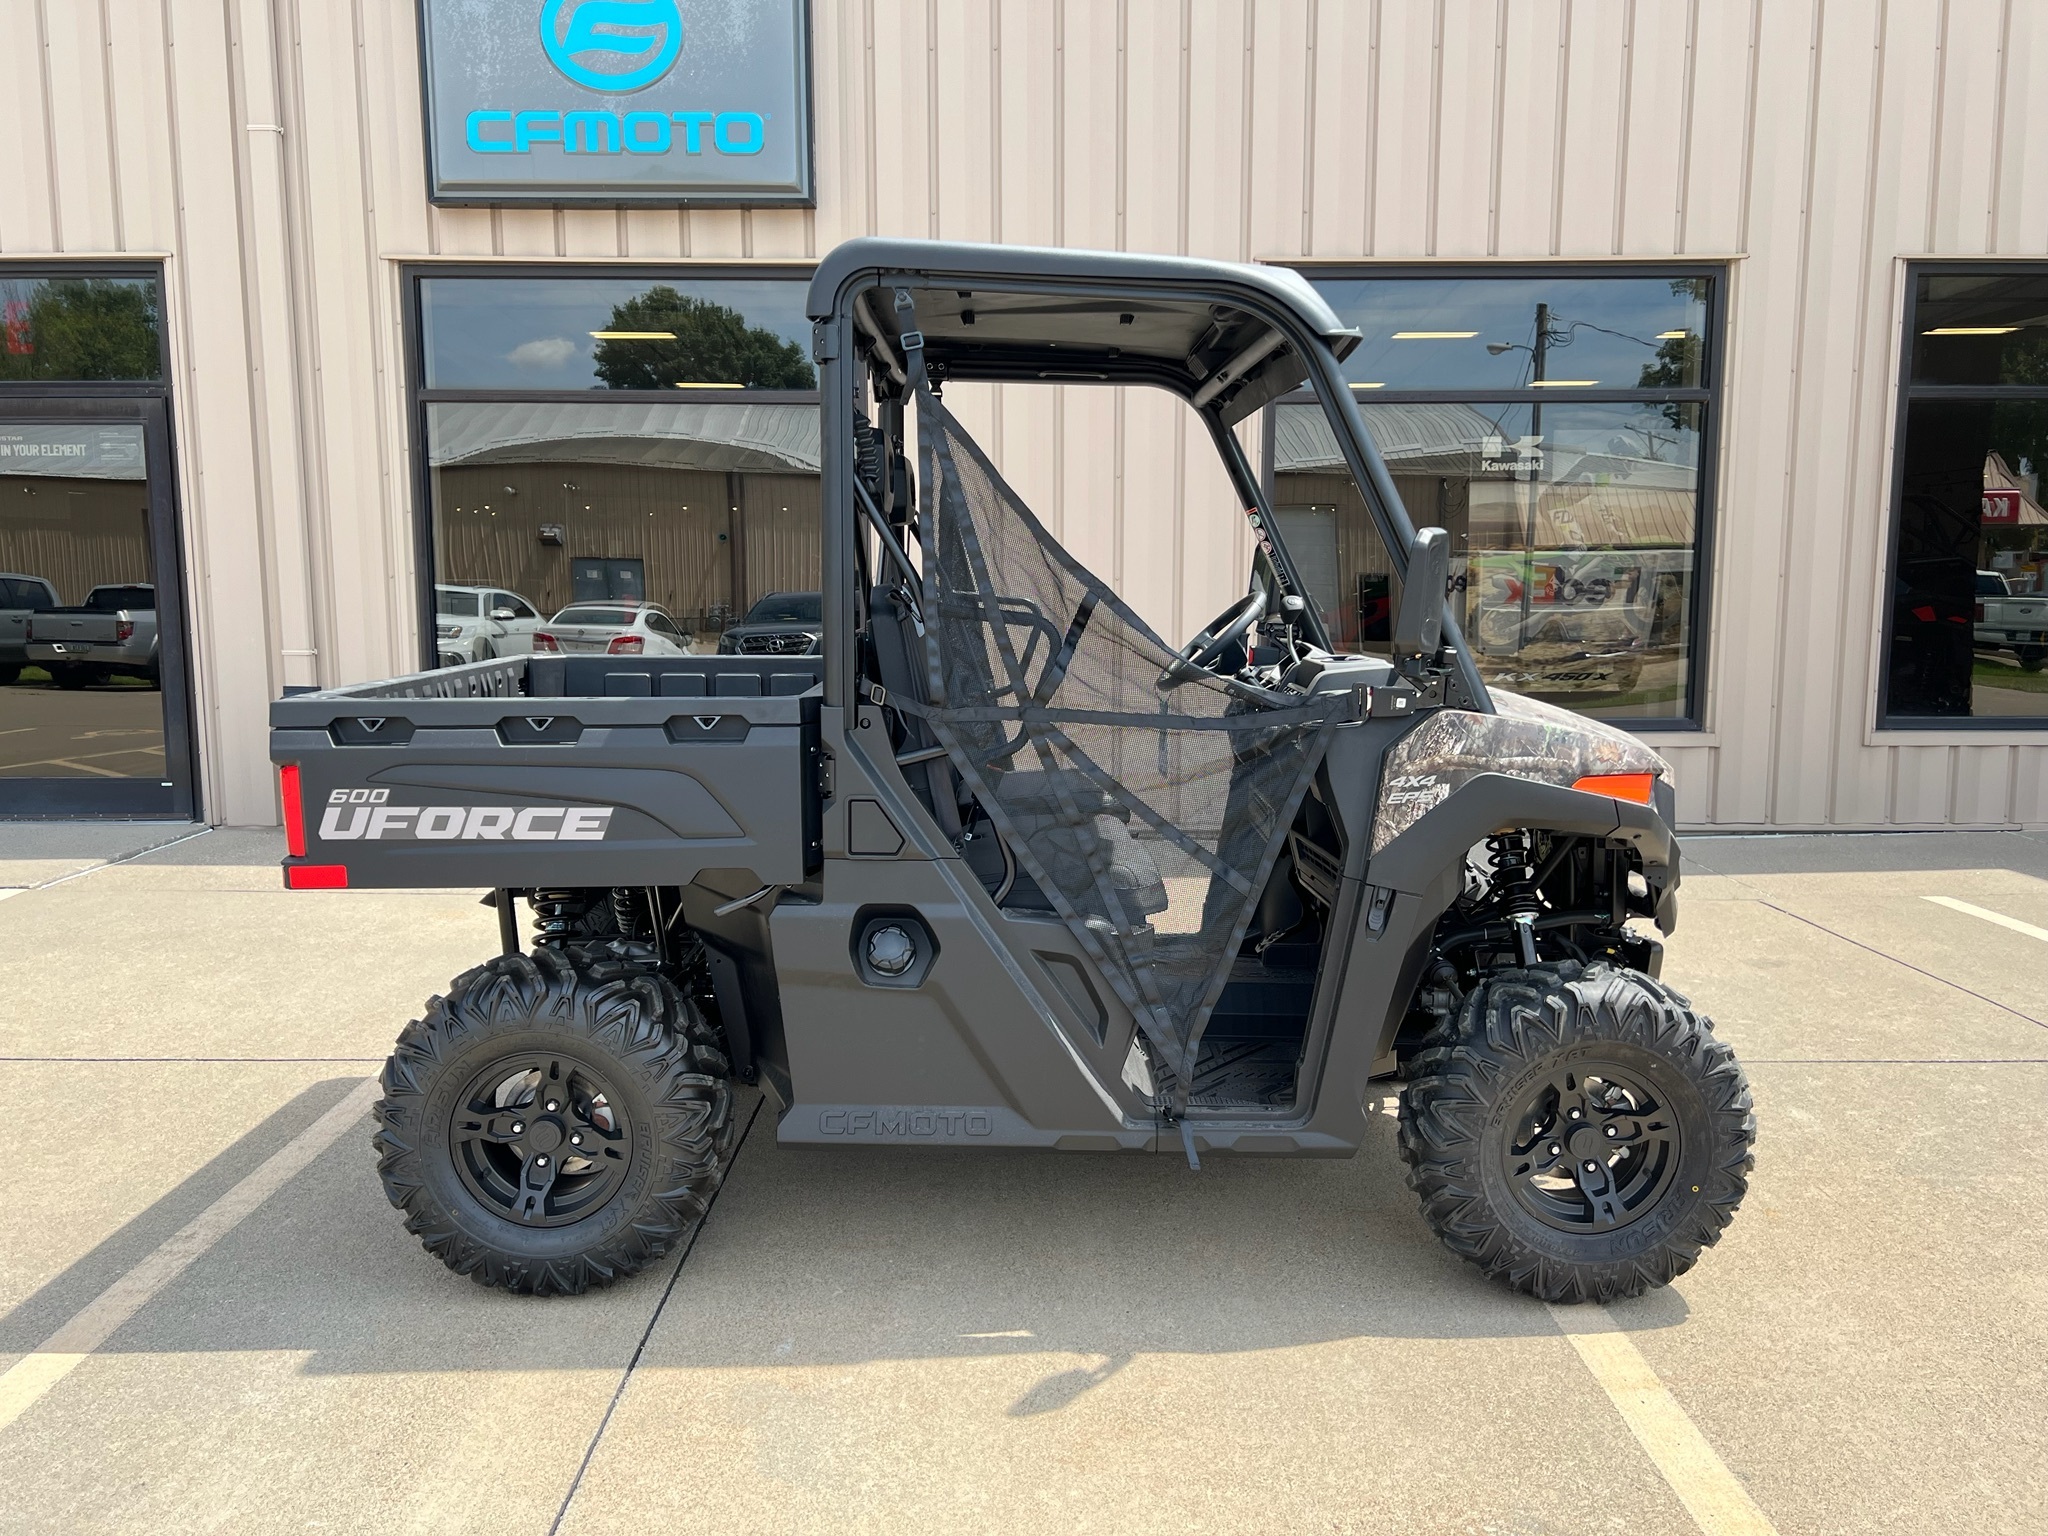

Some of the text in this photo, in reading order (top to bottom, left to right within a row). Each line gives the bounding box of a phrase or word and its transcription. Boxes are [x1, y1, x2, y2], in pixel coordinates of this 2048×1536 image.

[466, 110, 764, 154] CFMOTO
[1, 444, 12, 457] IN
[12, 444, 40, 457] YOUR
[41, 443, 87, 456] ELEMENT
[1481, 459, 1544, 471] Kawasaki
[1389, 774, 1438, 788] 4X4
[328, 788, 390, 804] 600
[1386, 790, 1435, 805] EPS
[317, 806, 615, 841] UFORCE
[818, 1109, 993, 1137] CFMOTO
